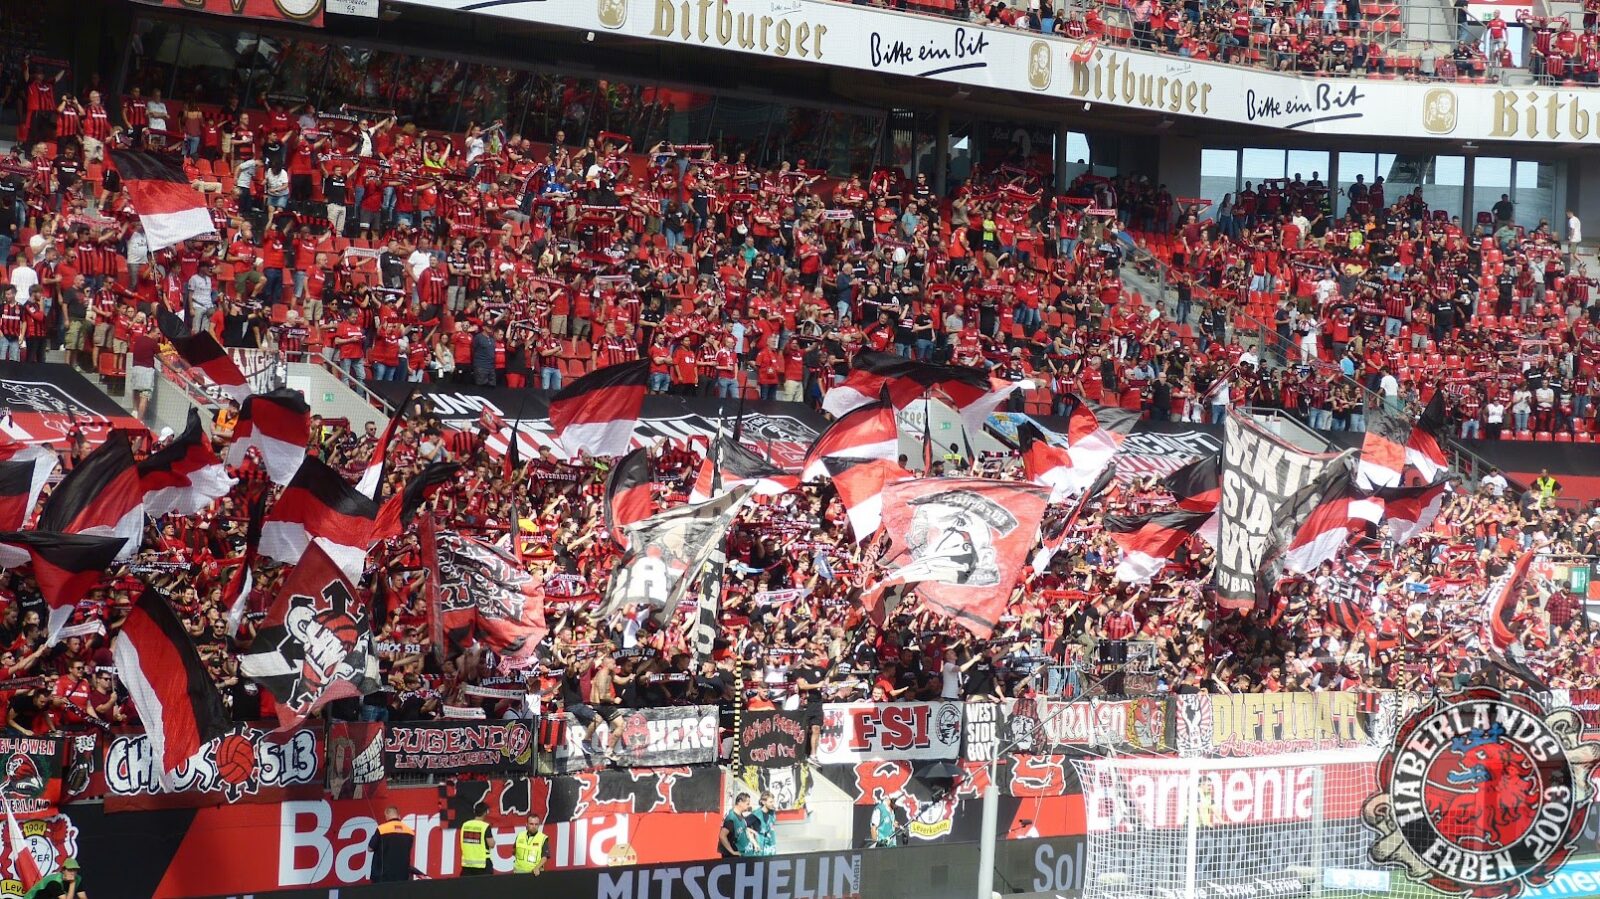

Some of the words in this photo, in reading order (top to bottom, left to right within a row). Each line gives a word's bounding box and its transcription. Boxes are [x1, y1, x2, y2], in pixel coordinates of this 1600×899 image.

[650, 0, 828, 60] Bitburger
[870, 32, 914, 67] Bitte
[919, 39, 951, 61] ein
[955, 27, 990, 58] Bit
[1070, 47, 1212, 115] Bitburger
[1247, 88, 1282, 121] Bitte
[1285, 95, 1313, 114] ein
[1316, 83, 1366, 111] Bit
[1488, 89, 1600, 141] Bitb
[1225, 415, 1325, 499] SEKTI
[848, 703, 932, 752] FSI
[966, 702, 997, 723] WEST
[384, 725, 508, 754] JUGEND
[395, 750, 501, 769] LEVERKUSEN
[105, 735, 216, 796] CHOS
[257, 728, 319, 788] 513
[25, 823, 45, 834] 1904
[597, 856, 856, 899] MITSCHELIN
[851, 855, 862, 892] GMBH
